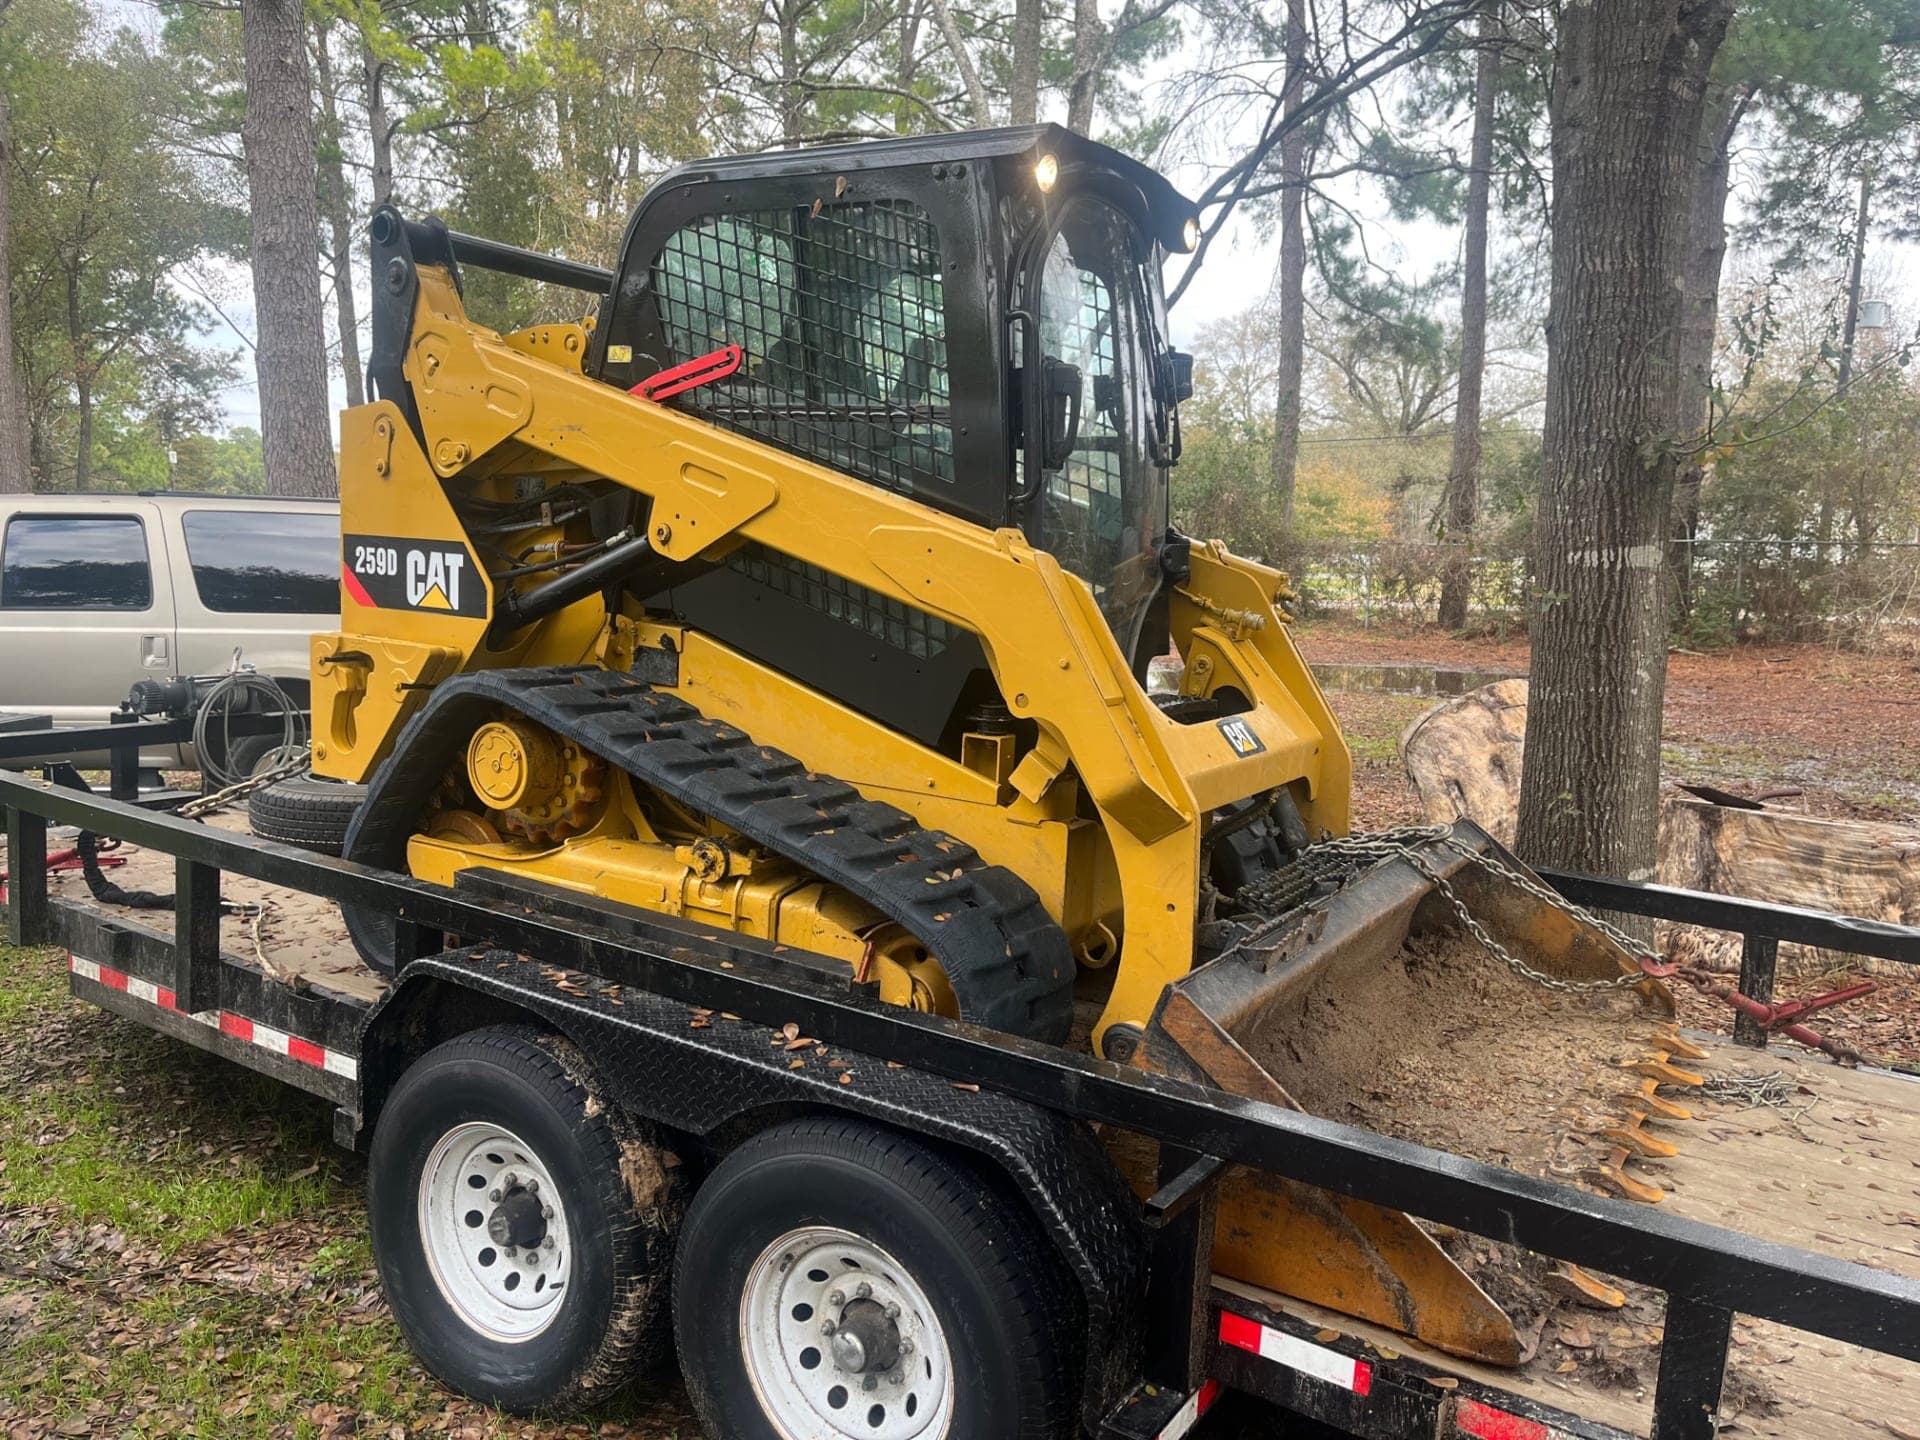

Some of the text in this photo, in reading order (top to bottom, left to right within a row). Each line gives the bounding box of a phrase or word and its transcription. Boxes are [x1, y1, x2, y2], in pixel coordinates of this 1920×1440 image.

[355, 546, 464, 610] 259D CAT
[1222, 721, 1258, 753] CAT
